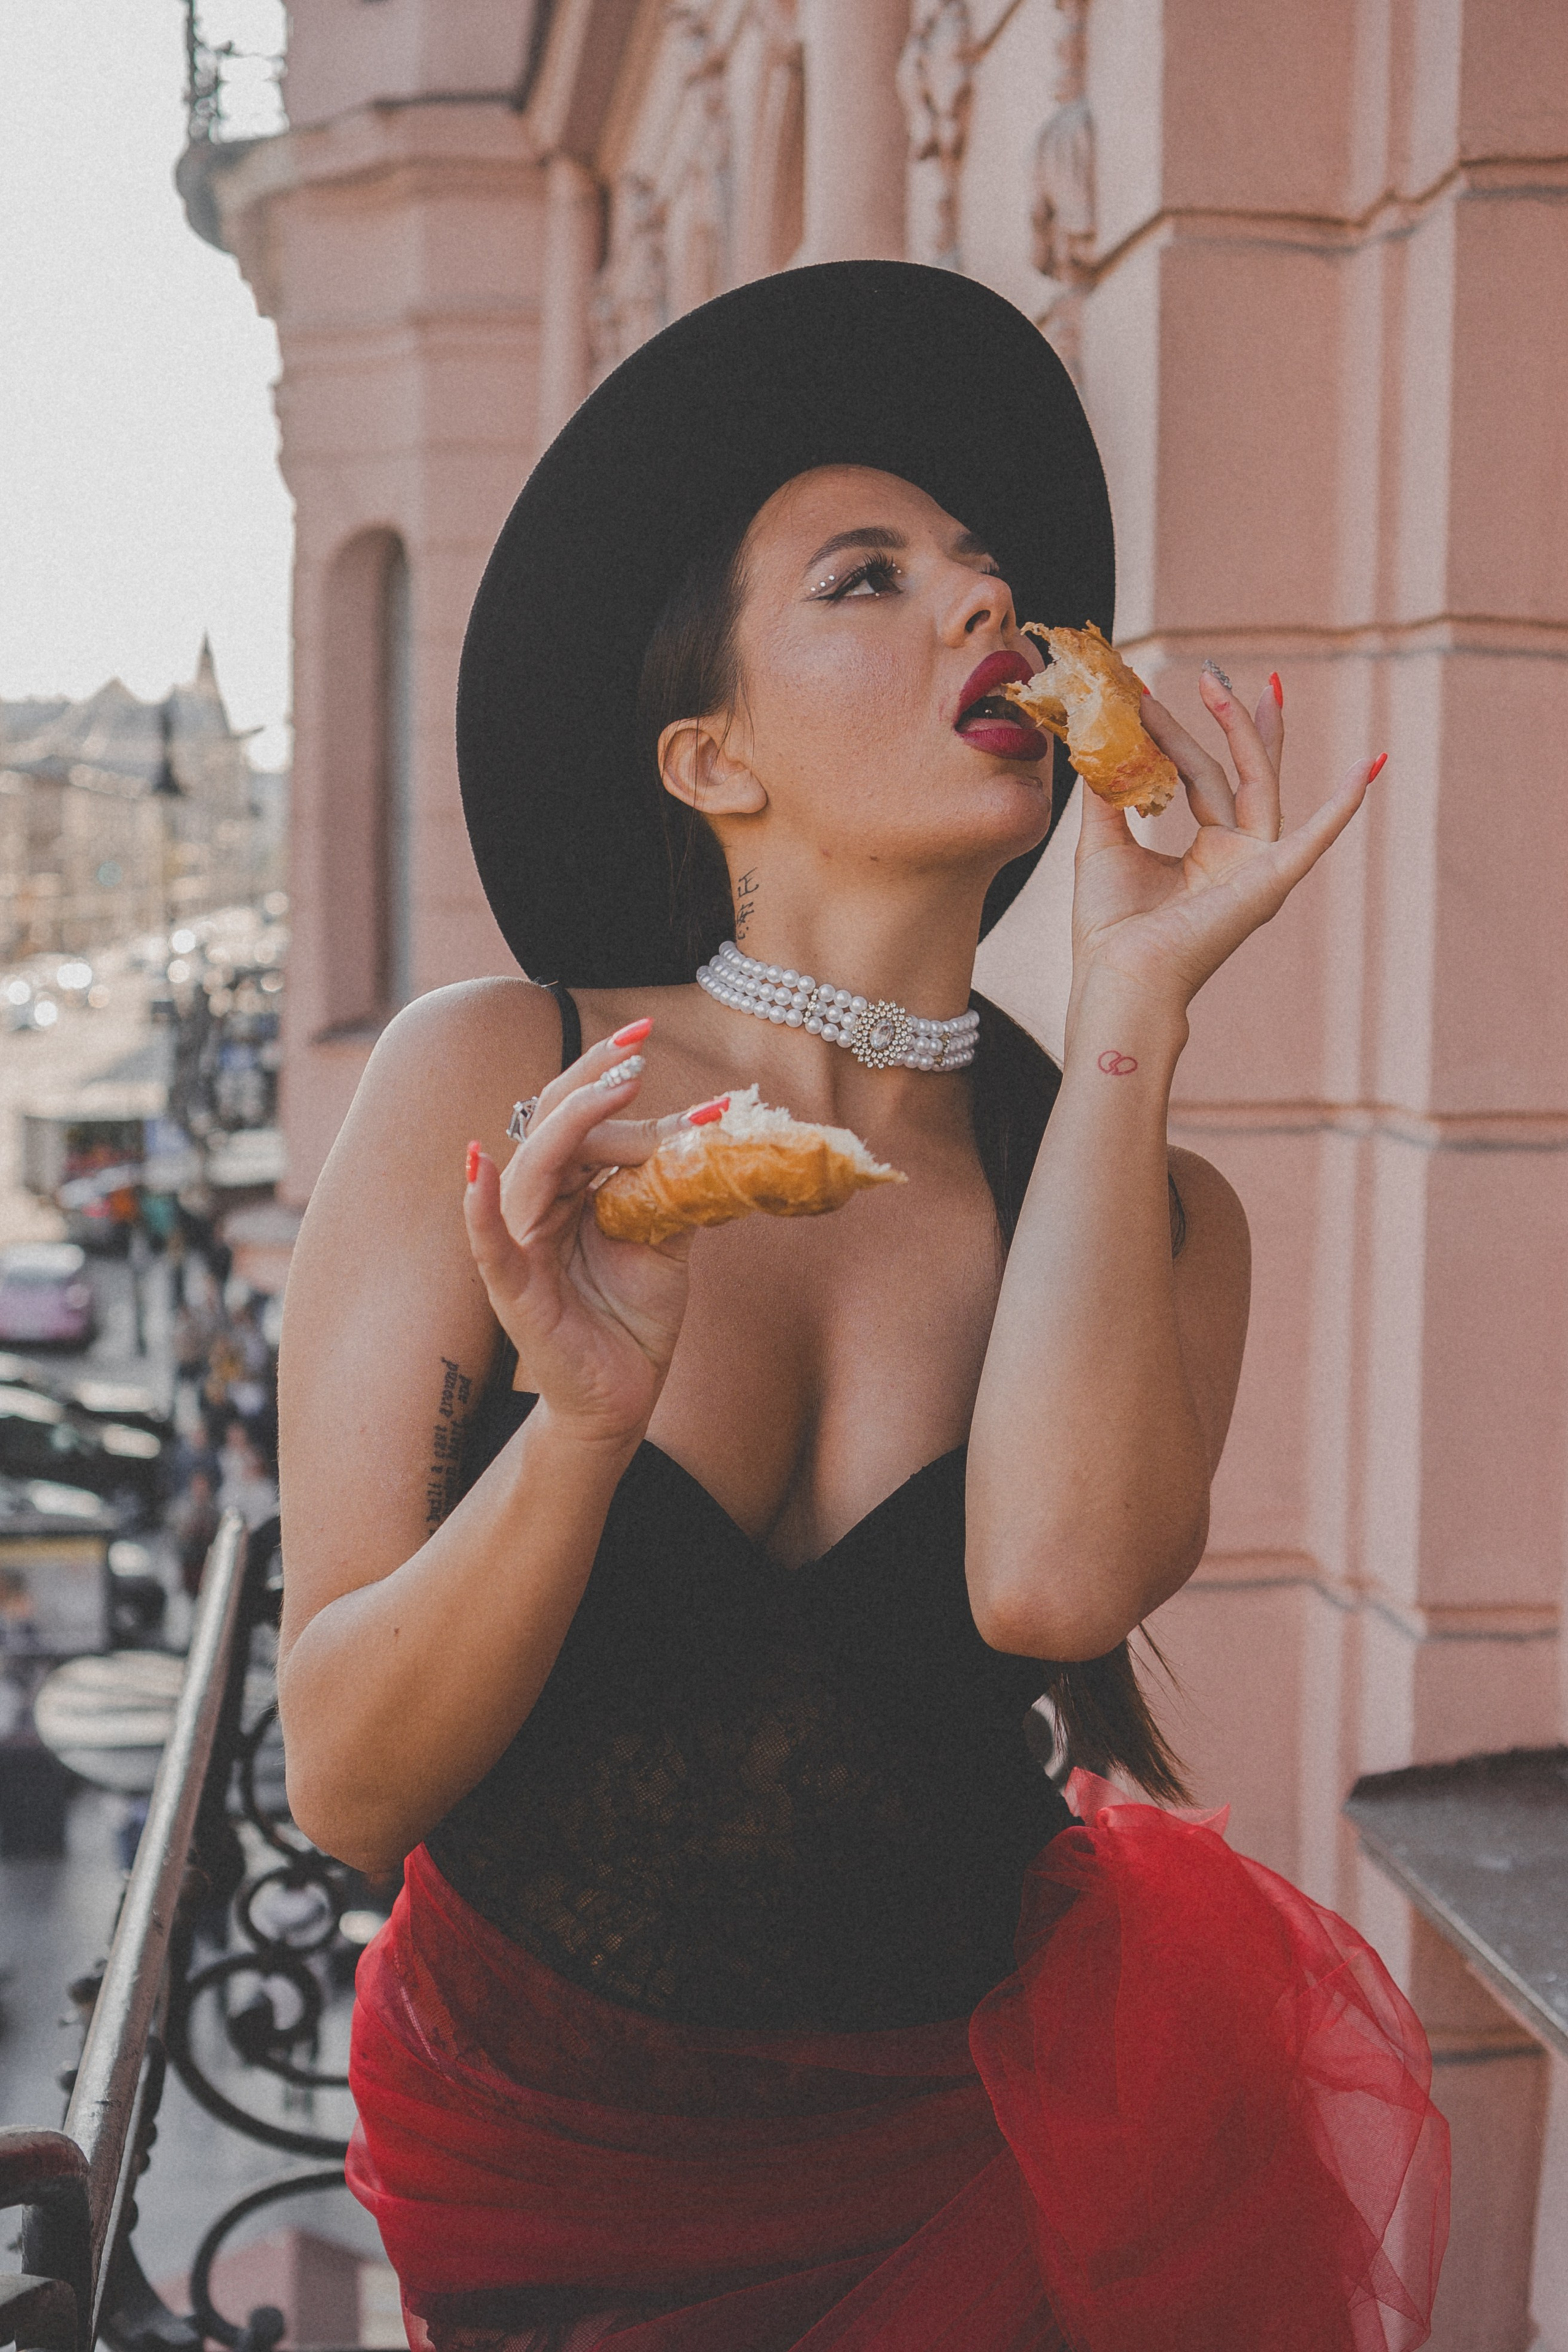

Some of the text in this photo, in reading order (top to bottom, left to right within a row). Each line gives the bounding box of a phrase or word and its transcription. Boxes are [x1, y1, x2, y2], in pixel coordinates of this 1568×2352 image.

[440, 1357, 458, 1418] around
[458, 1374, 472, 1404] and
[434, 1425, 447, 1459] cast
[427, 1483, 442, 1521] built
